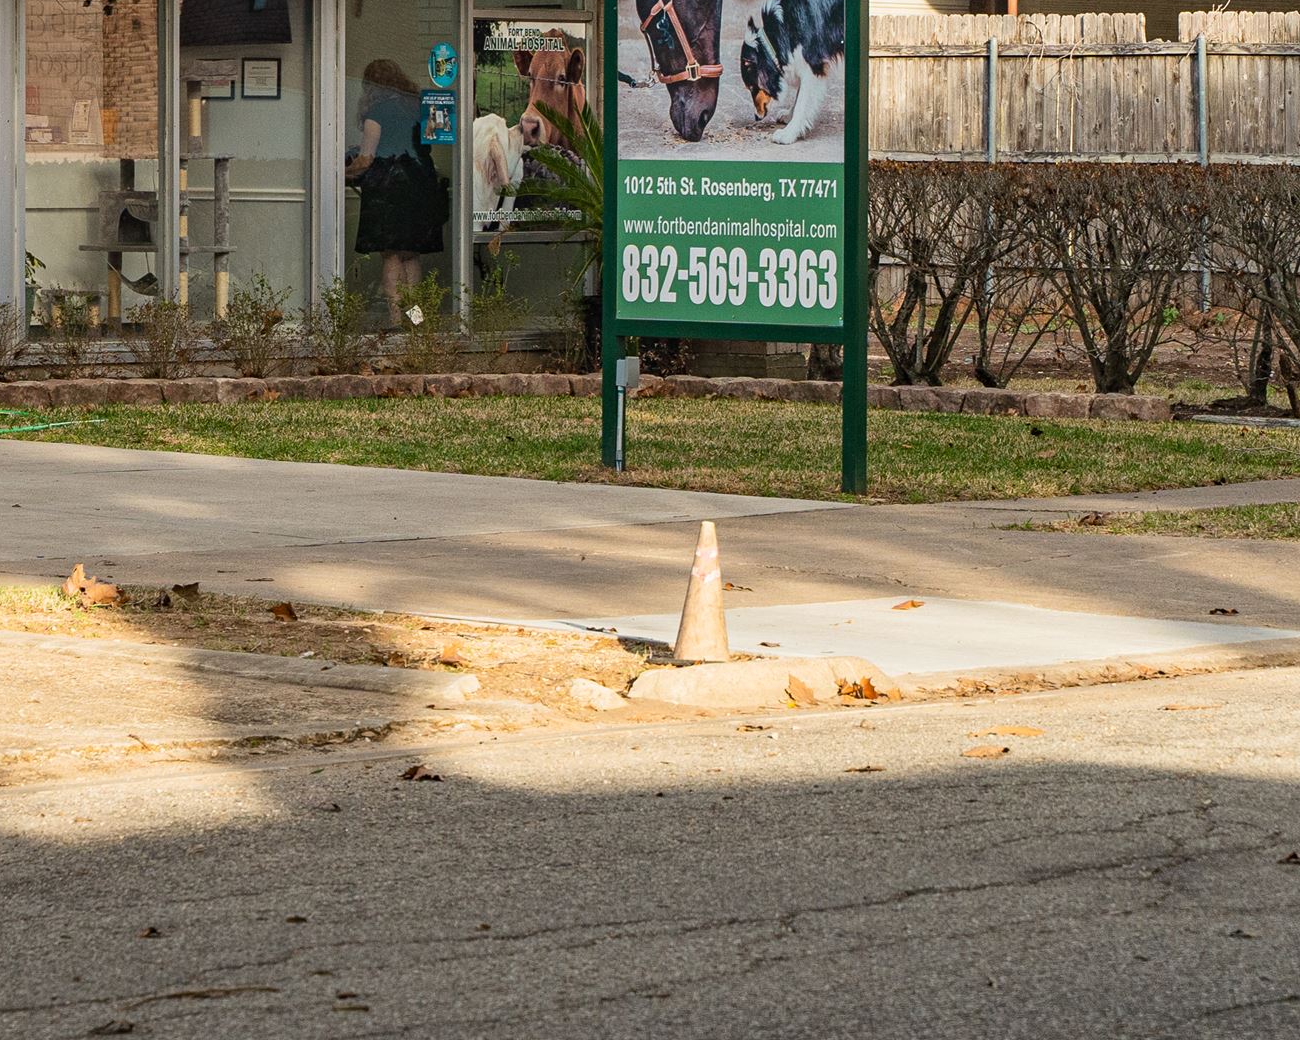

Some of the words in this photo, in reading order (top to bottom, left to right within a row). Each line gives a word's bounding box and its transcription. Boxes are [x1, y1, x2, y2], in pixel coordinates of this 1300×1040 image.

[484, 36, 518, 51] ANIMAL
[521, 37, 565, 52] HOSPITAL
[508, 27, 523, 37] FORT
[525, 28, 541, 38] BEND
[624, 175, 653, 195] 1012
[657, 177, 677, 196] 5th
[680, 177, 698, 196] St.
[701, 177, 775, 202] Rosenberg,
[779, 178, 797, 198] TX
[800, 179, 838, 199] 77471
[623, 215, 838, 242] www.fortbendanimalhospital.com
[622, 244, 838, 310] 832-569-3363
